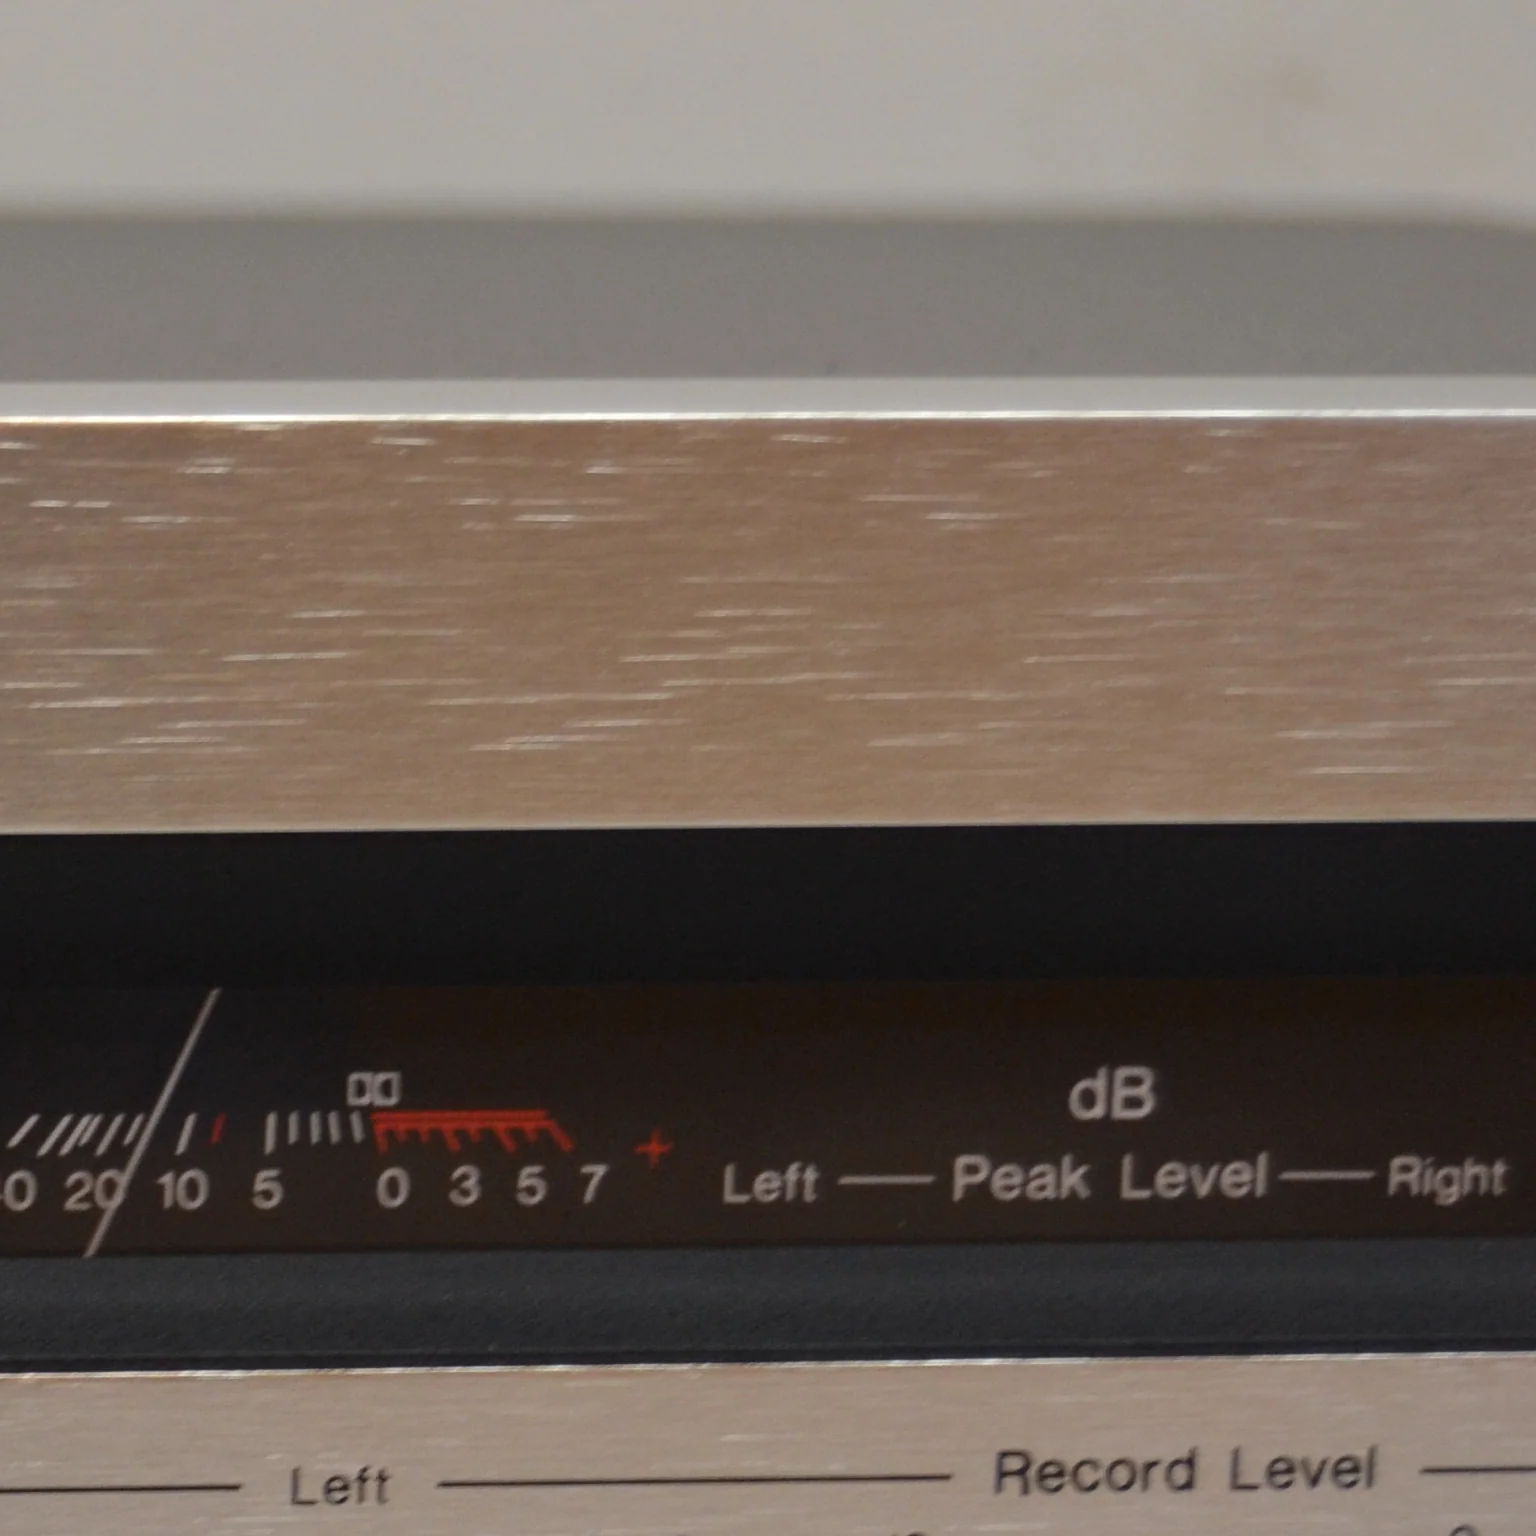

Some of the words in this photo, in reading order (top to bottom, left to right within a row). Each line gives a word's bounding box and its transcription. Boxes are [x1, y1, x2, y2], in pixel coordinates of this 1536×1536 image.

[1069, 1066, 1155, 1120] dB
[64, 1169, 128, 1211] 20
[158, 1169, 208, 1210] 10
[253, 1169, 283, 1209] 5
[377, 1167, 409, 1208] 0
[450, 1164, 480, 1206] 3
[517, 1165, 547, 1206] 5
[581, 1163, 608, 1203] 7
[723, 1162, 819, 1203] Left
[953, 1154, 1089, 1201] Peak
[1121, 1153, 1268, 1199] Level
[1388, 1155, 1507, 1205] Right
[291, 1466, 389, 1506] Left
[995, 1449, 1197, 1495] Record
[1230, 1447, 1376, 1491] Level
